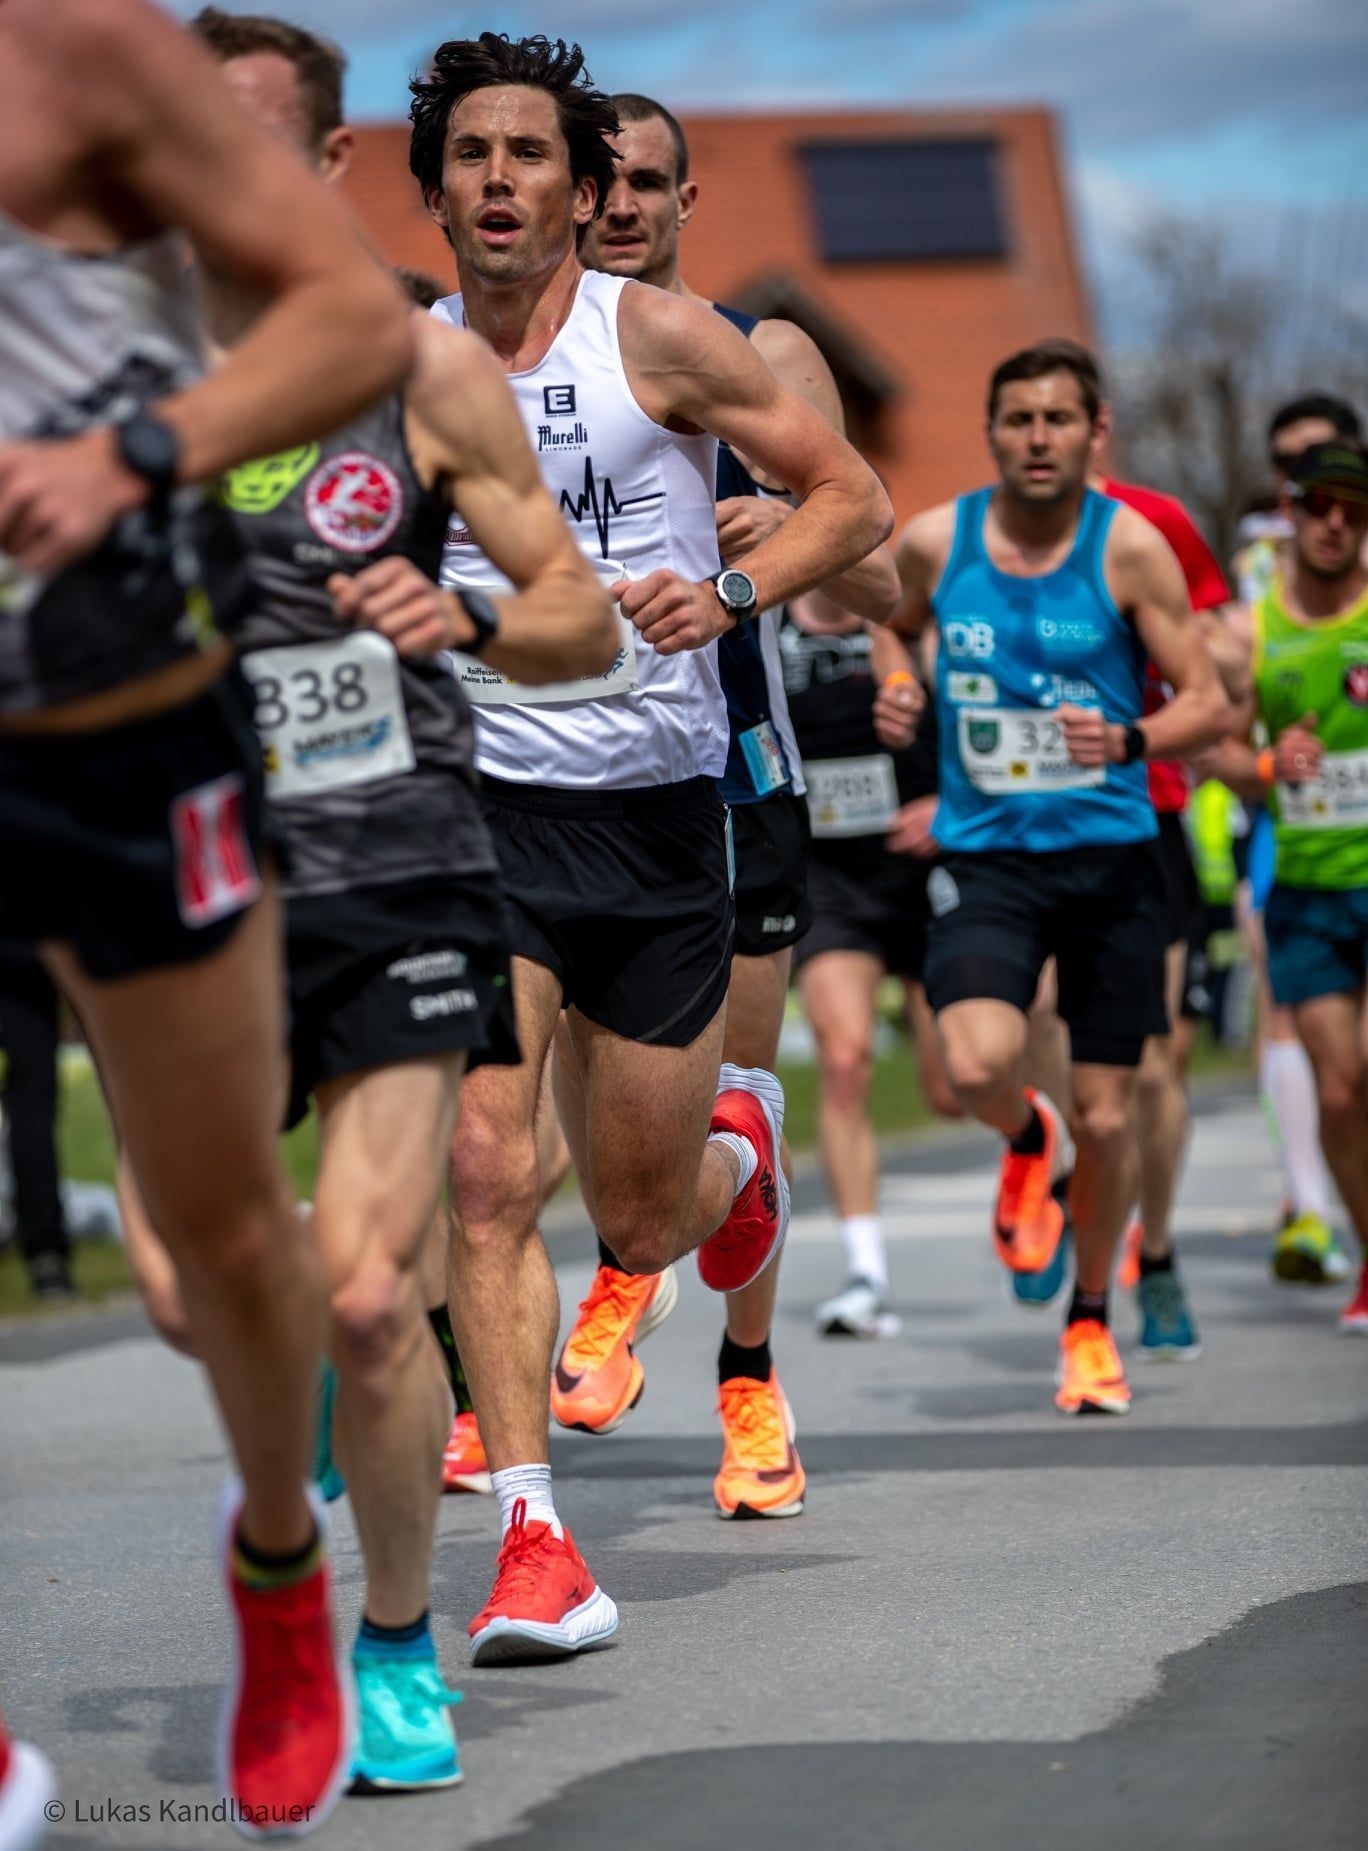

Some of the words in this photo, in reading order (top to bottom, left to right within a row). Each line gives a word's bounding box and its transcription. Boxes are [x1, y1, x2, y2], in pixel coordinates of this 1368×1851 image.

[545, 386, 573, 412] E
[537, 422, 588, 452] Murelli
[545, 445, 582, 453] LIMONADE
[461, 675, 481, 684] Meine
[482, 676, 503, 685] Bank
